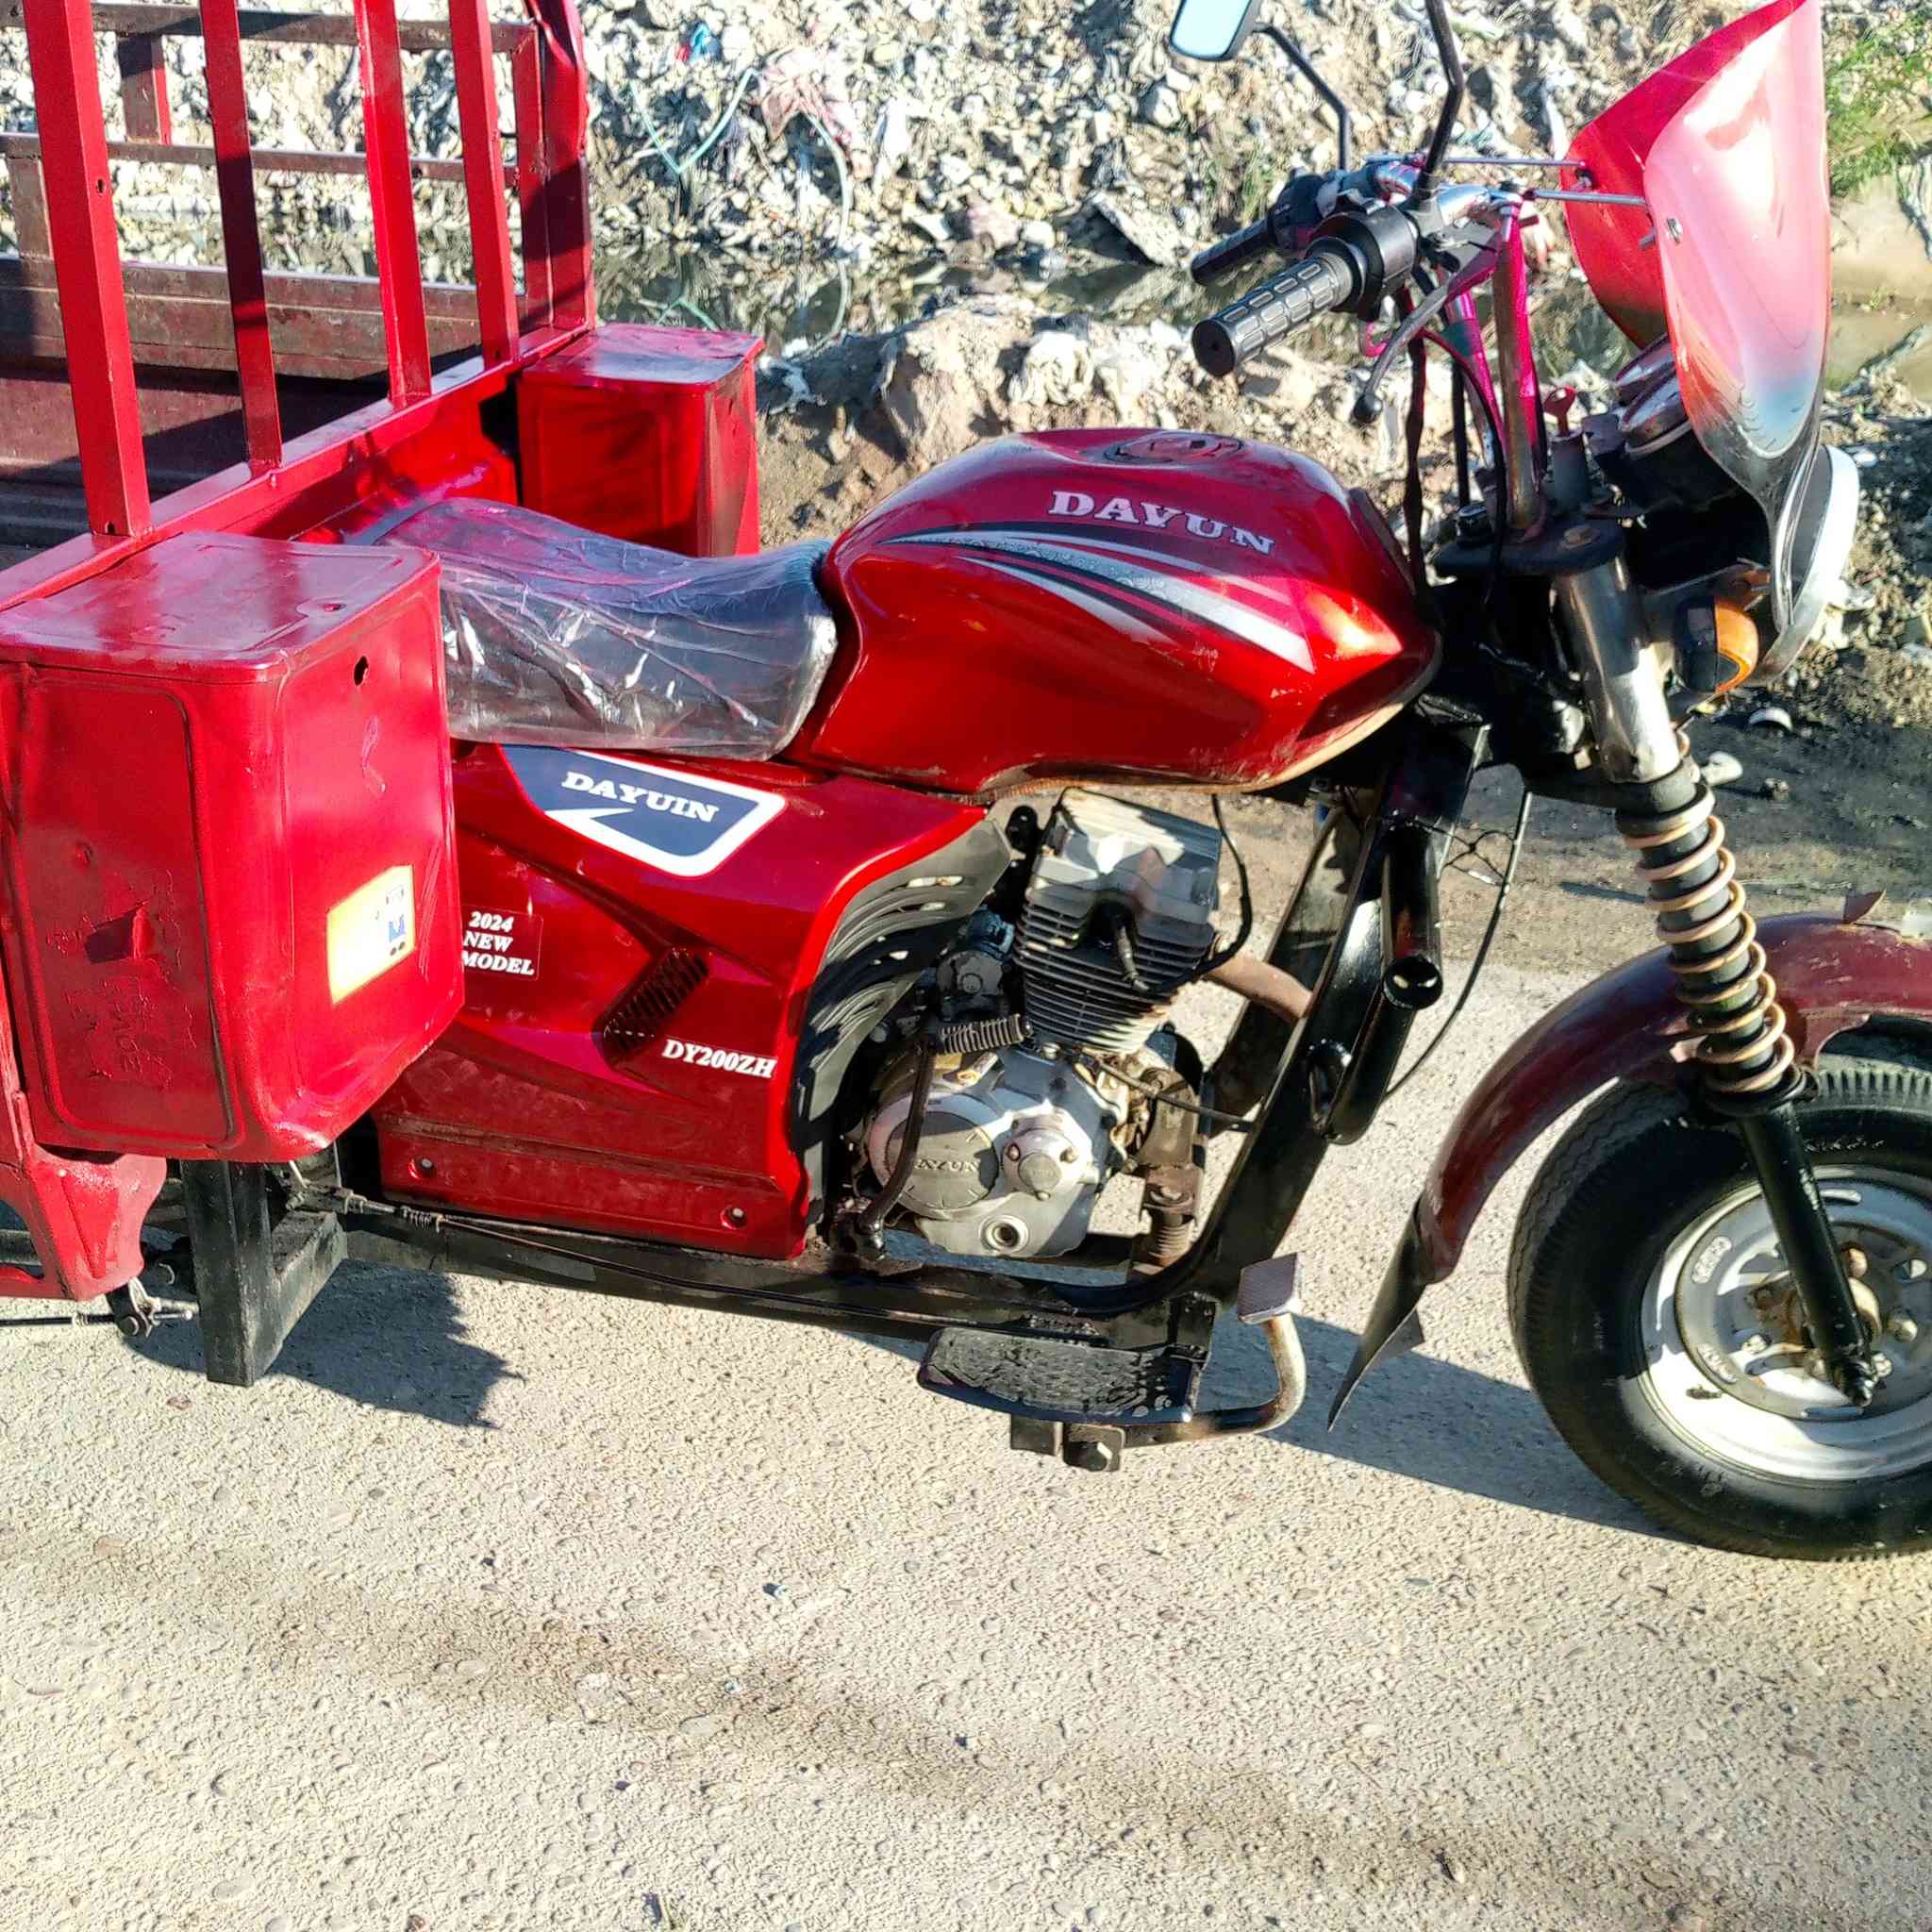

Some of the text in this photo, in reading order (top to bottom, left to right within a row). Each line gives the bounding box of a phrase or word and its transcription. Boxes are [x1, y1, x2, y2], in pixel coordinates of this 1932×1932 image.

[1048, 491, 1274, 554] DAYUN
[468, 910, 515, 933] 2024
[462, 930, 513, 953] NEW
[461, 950, 535, 975] MODEL
[661, 1039, 777, 1078] DY200ZH
[912, 1158, 979, 1172] AYUN
